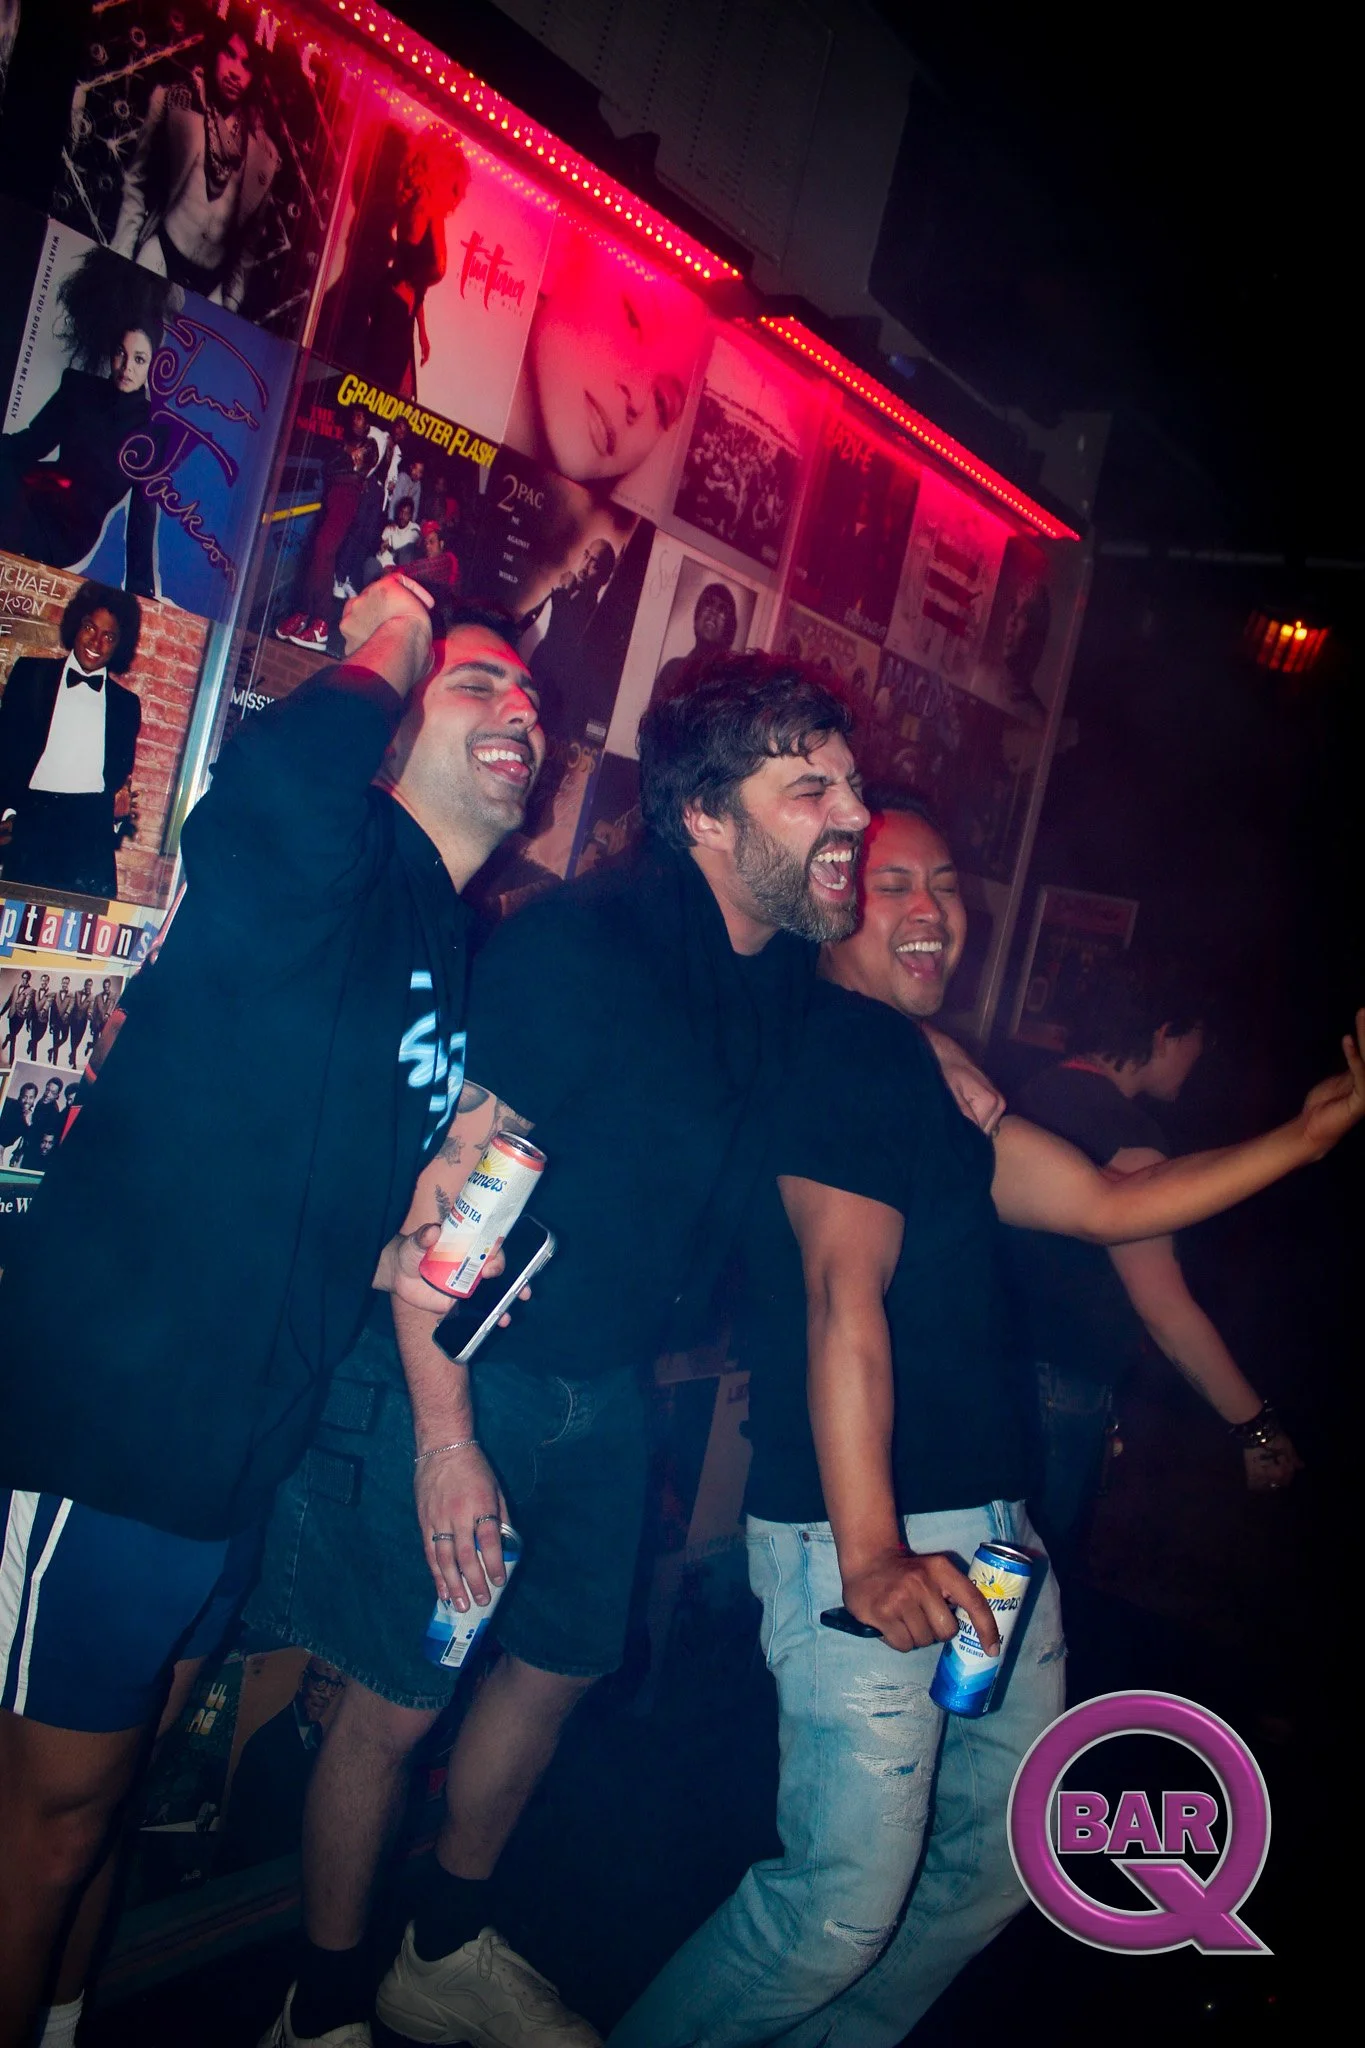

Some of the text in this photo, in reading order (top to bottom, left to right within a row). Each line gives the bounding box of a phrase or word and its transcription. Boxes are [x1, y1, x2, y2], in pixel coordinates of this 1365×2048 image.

[12, 235, 60, 419] WHAT HAVE YOU DONE FOR ME LATELY
[150, 317, 268, 433] Janet
[337, 373, 454, 448] GRANDMASTER
[447, 427, 499, 470] FLASH
[118, 402, 238, 594] Jackson
[497, 473, 545, 512] 2PAC
[0, 905, 153, 961] ptations
[468, 1208, 482, 1224] TEA
